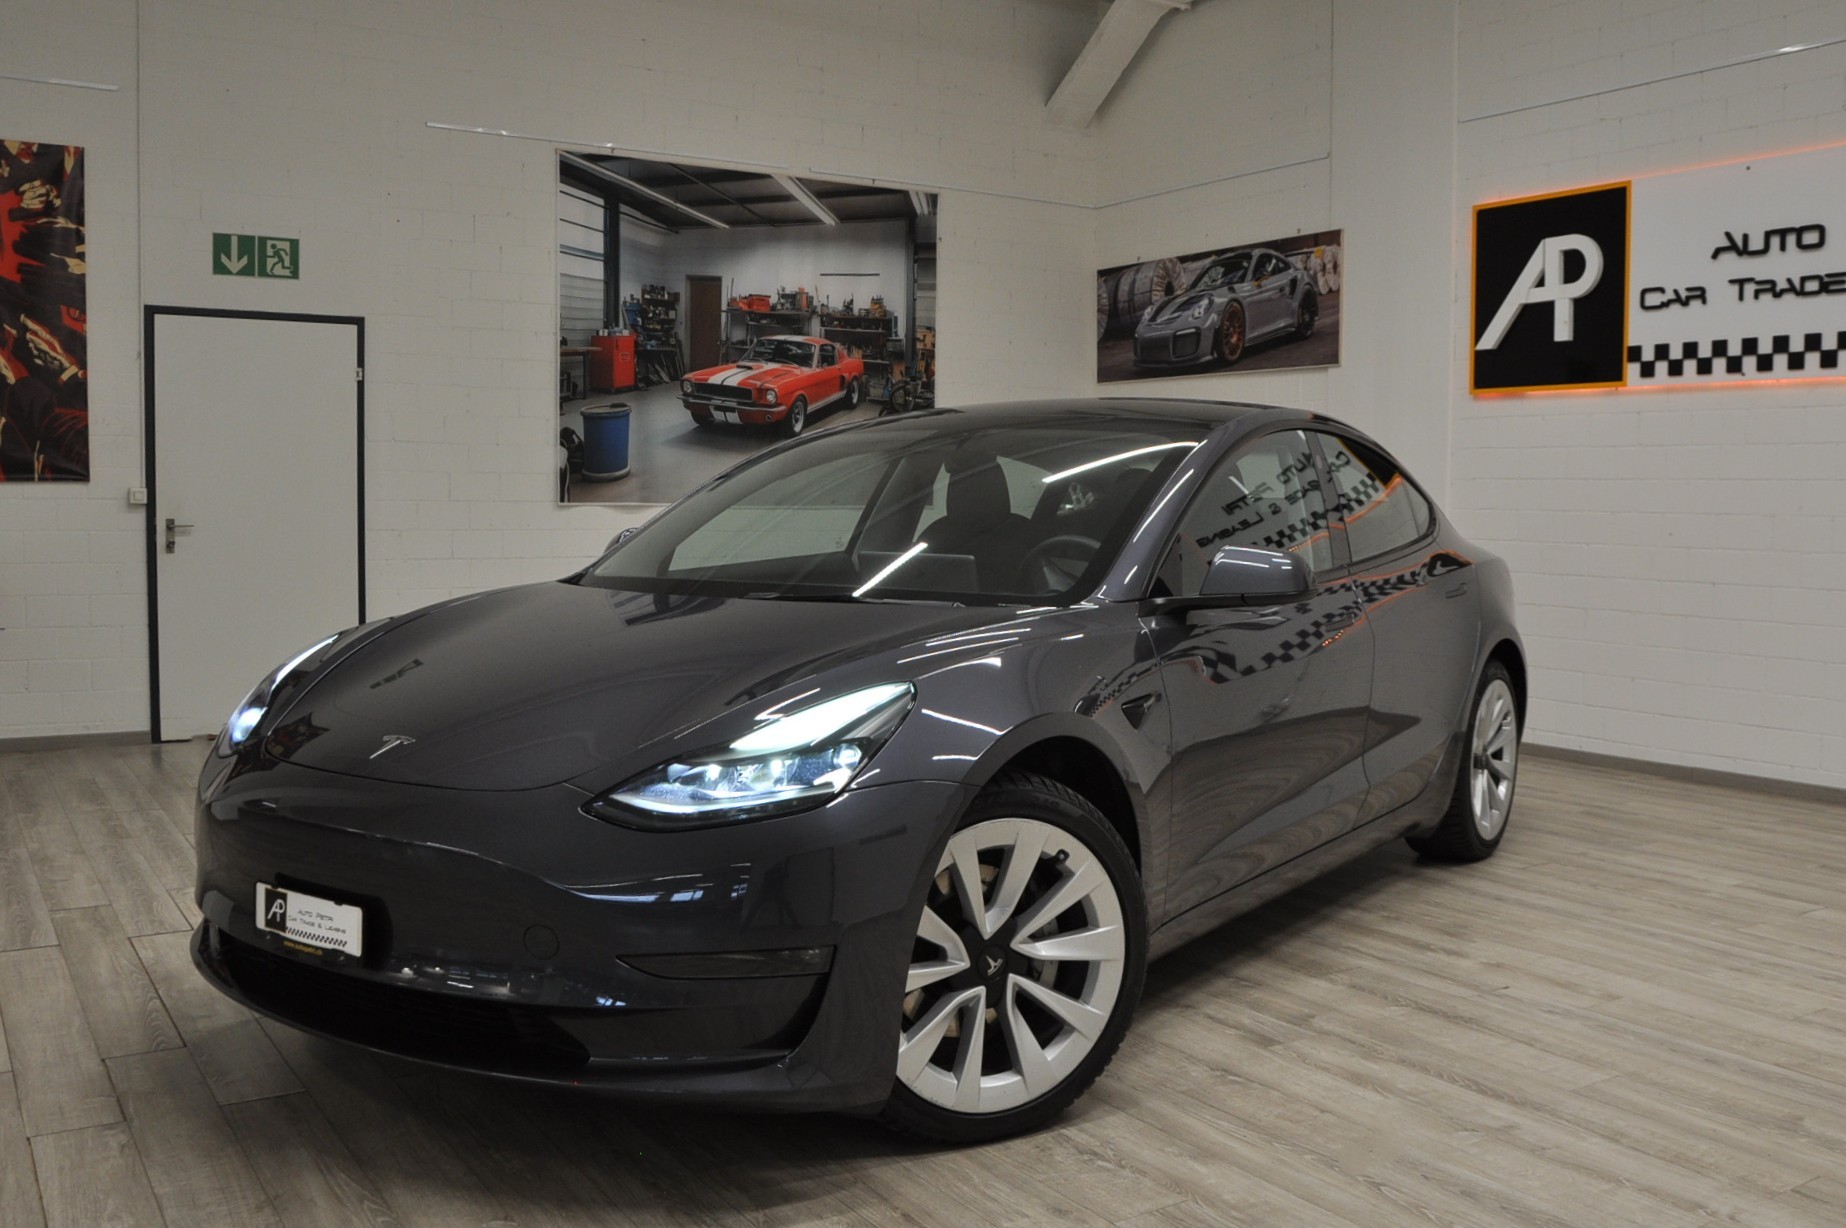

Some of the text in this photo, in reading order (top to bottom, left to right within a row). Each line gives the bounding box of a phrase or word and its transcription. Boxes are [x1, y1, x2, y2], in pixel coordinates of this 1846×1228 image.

[1710, 223, 1827, 260] AUTO
[1639, 271, 1846, 312] CAR TRADE
